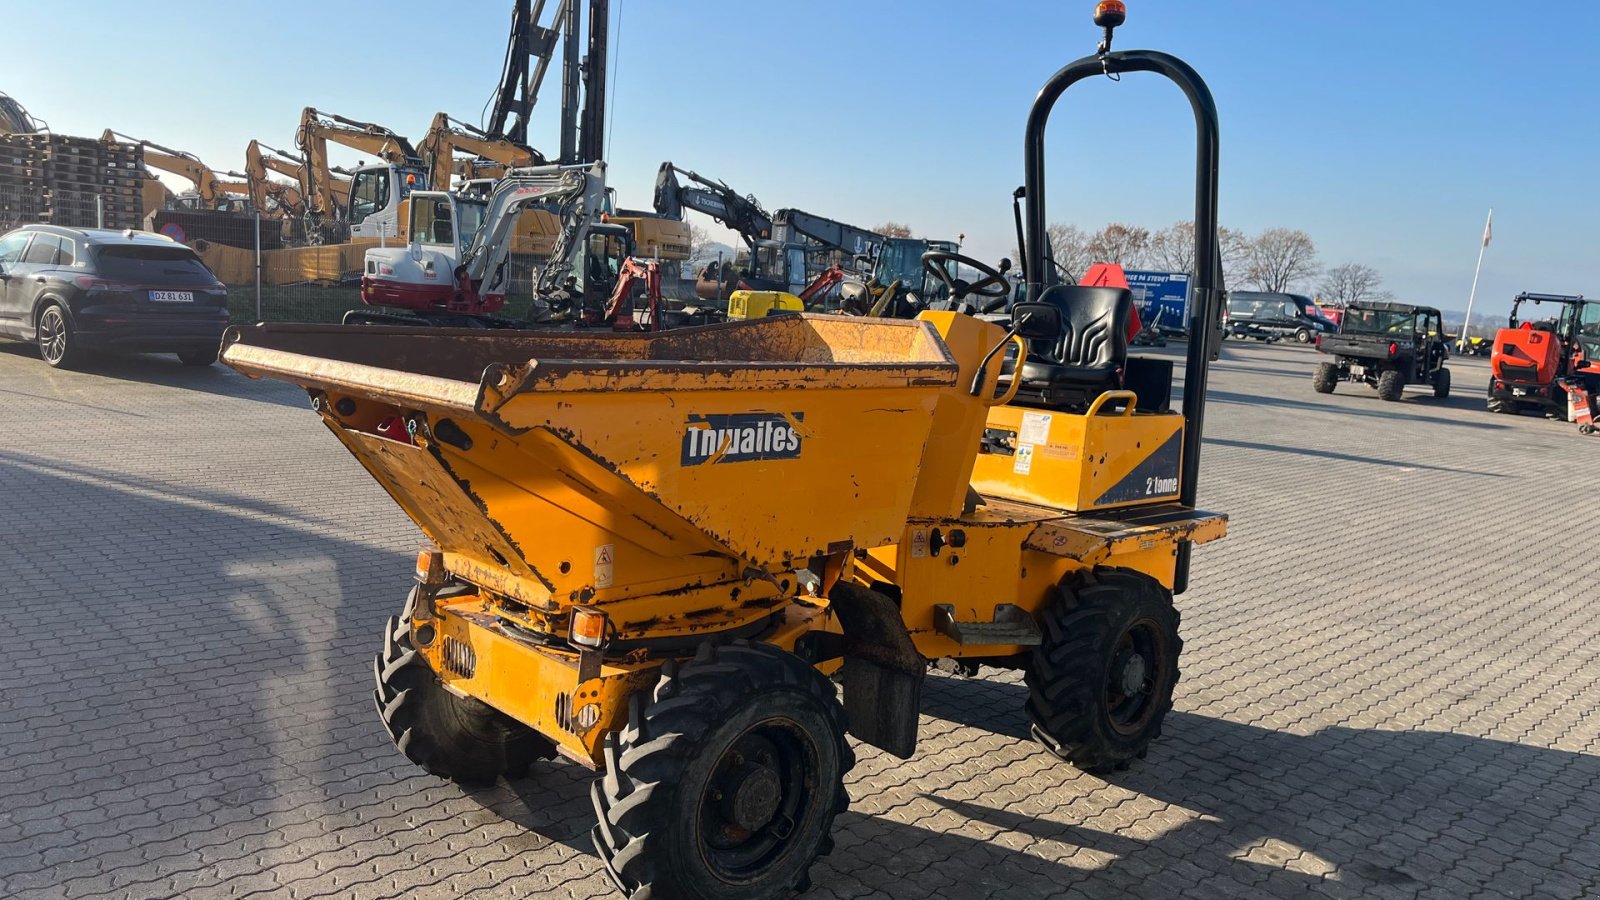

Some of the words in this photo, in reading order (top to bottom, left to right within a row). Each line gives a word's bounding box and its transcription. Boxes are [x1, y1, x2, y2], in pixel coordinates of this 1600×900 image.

[155, 292, 166, 300] DZ
[167, 292, 176, 300] 81
[178, 293, 192, 301] 631
[1145, 477, 1152, 495] 2
[1153, 476, 1178, 494] tonne
